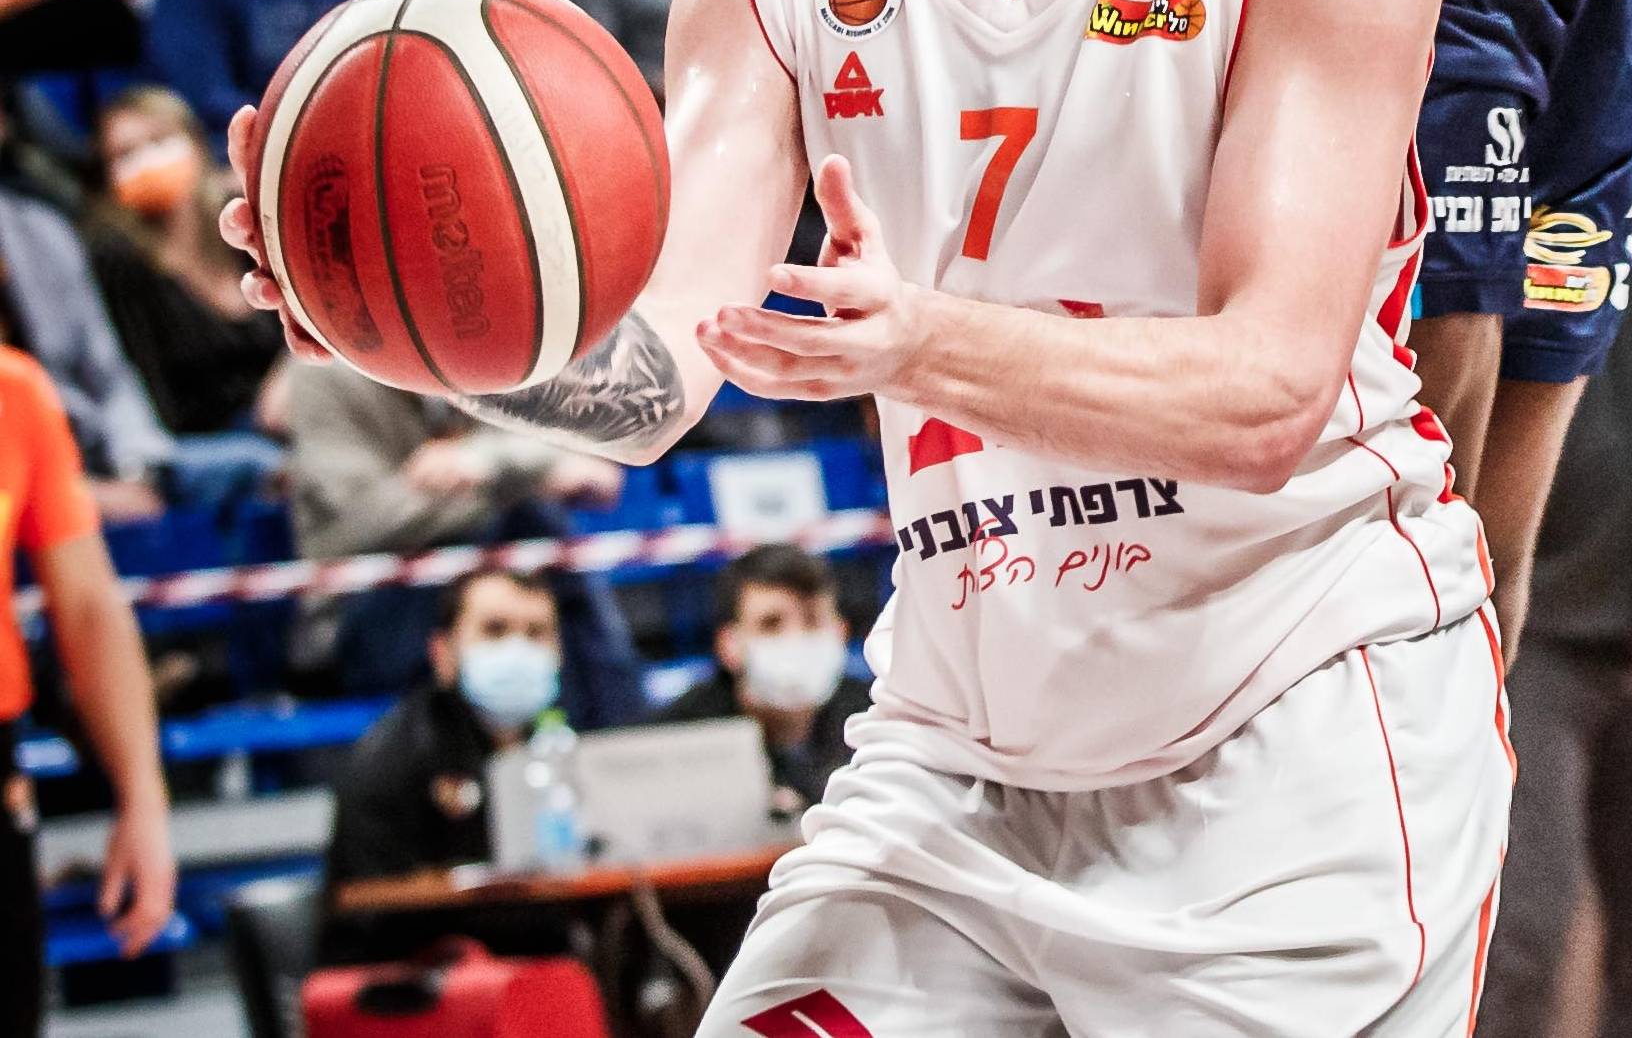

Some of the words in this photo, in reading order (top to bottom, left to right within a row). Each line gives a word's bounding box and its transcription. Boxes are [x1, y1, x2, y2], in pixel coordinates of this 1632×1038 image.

[1091, 4, 1168, 37] Winer
[960, 107, 1039, 262] 7
[418, 164, 491, 340] molten
[1028, 477, 1185, 528] צרפתי
[1054, 541, 1152, 592] בונים
